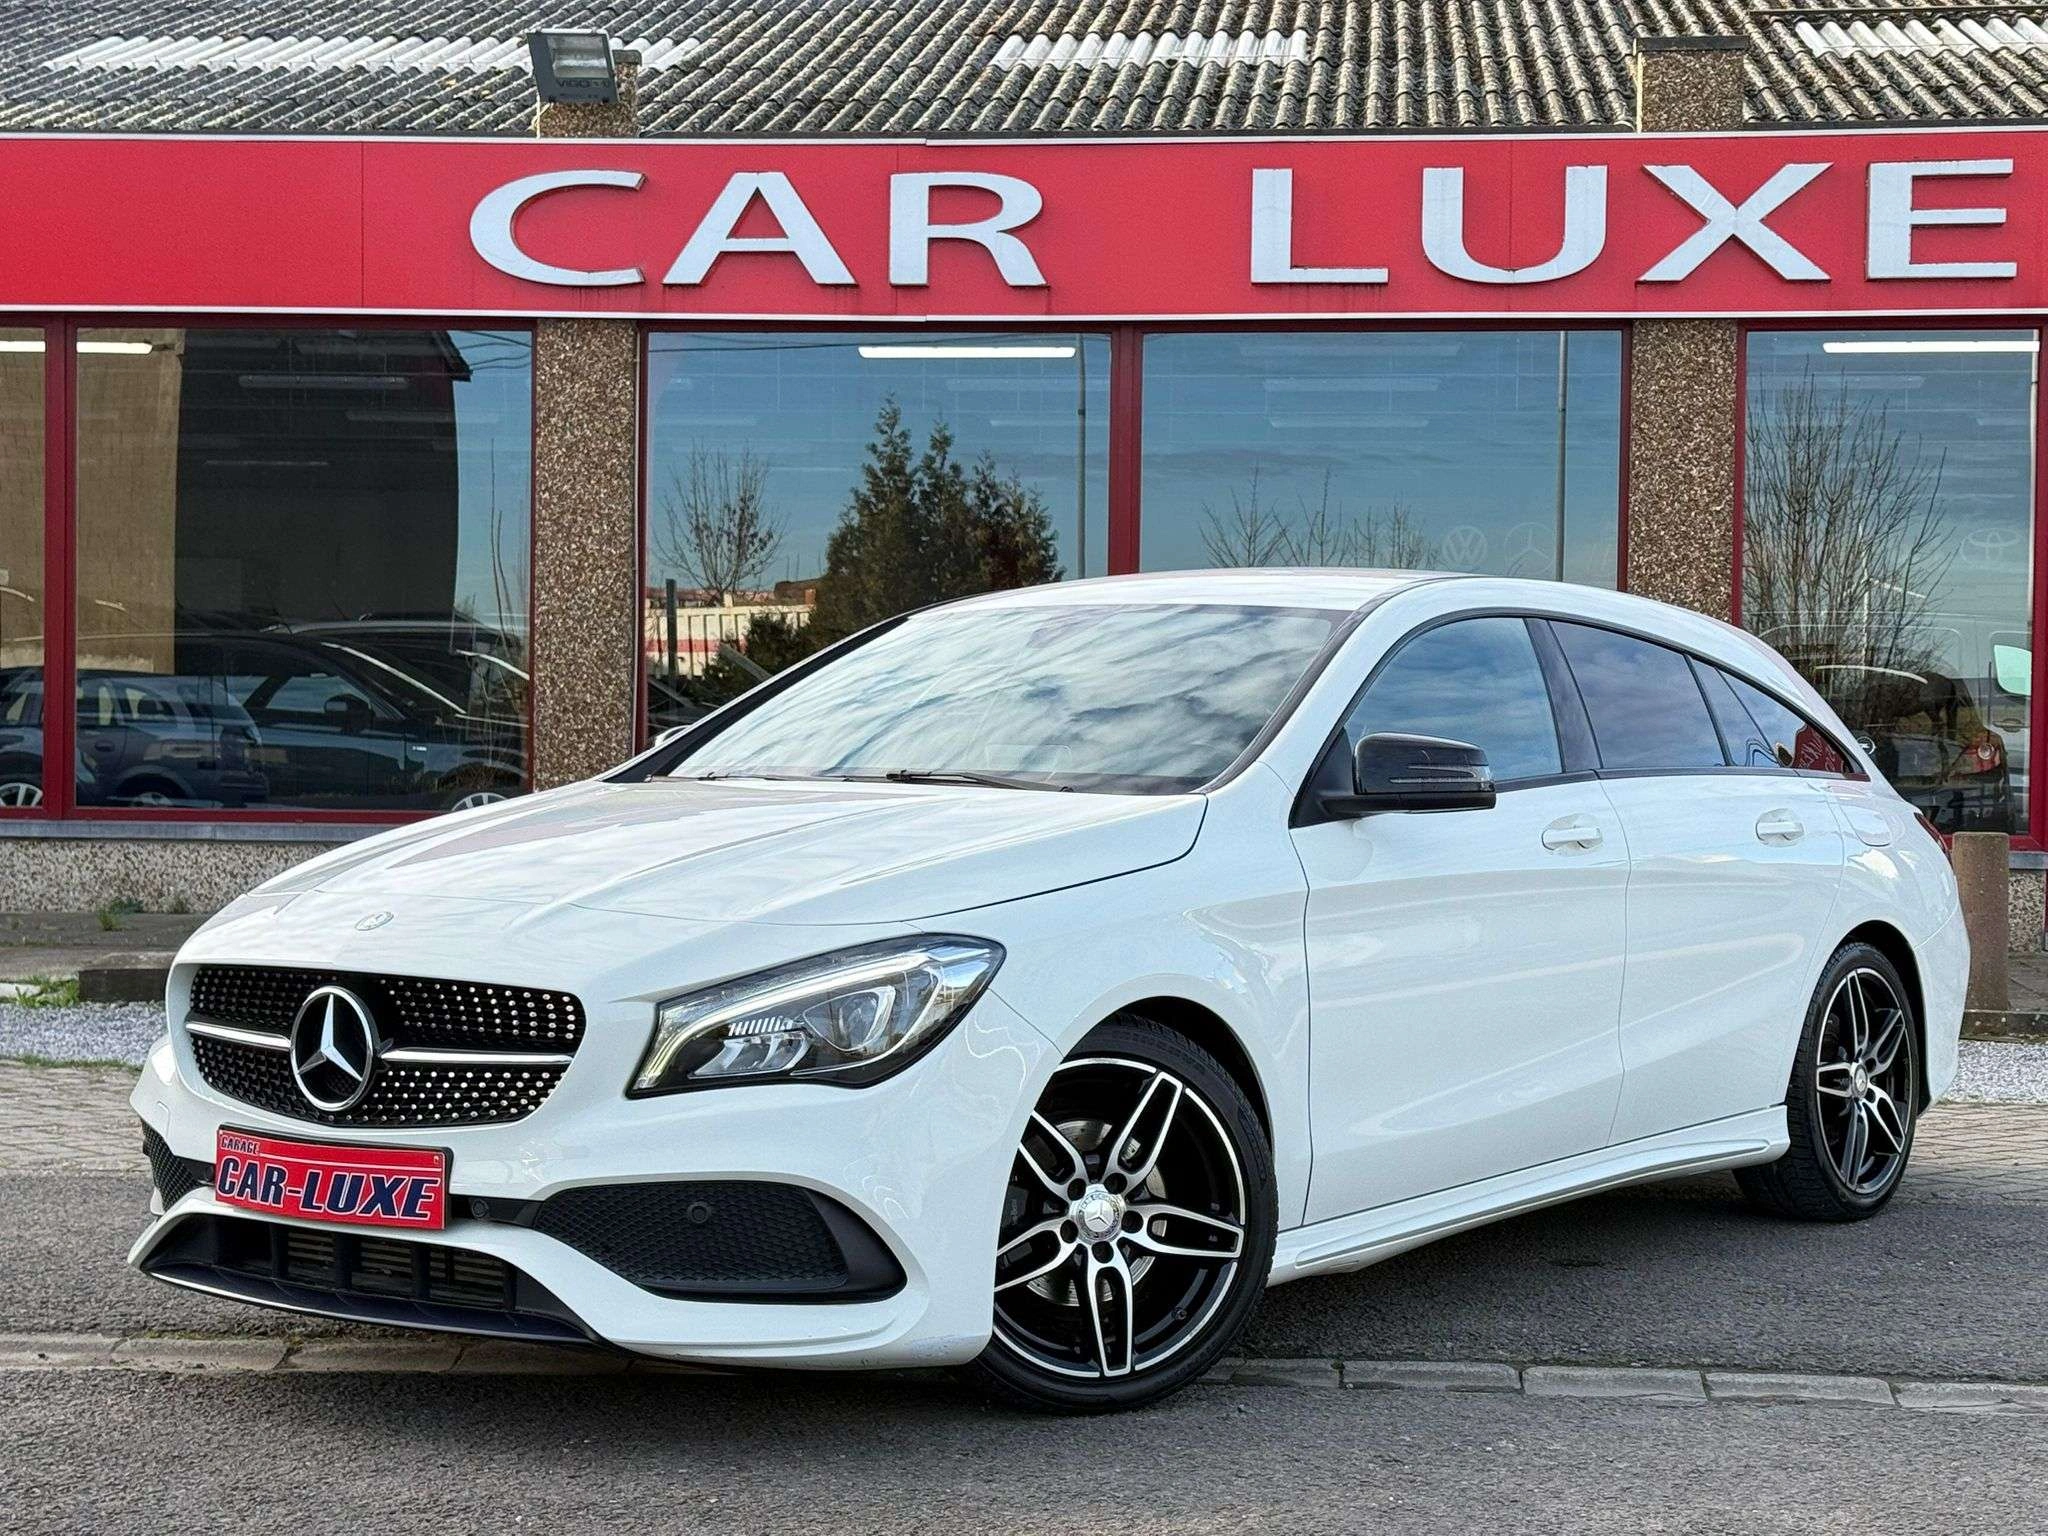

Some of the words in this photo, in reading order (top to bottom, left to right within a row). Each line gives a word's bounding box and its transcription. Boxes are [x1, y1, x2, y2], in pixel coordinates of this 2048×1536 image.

[469, 170, 1049, 287] CAR
[1251, 158, 2018, 284] LUXE
[221, 1135, 260, 1155] GARAGE
[217, 1157, 441, 1221] CAR-LUXE
